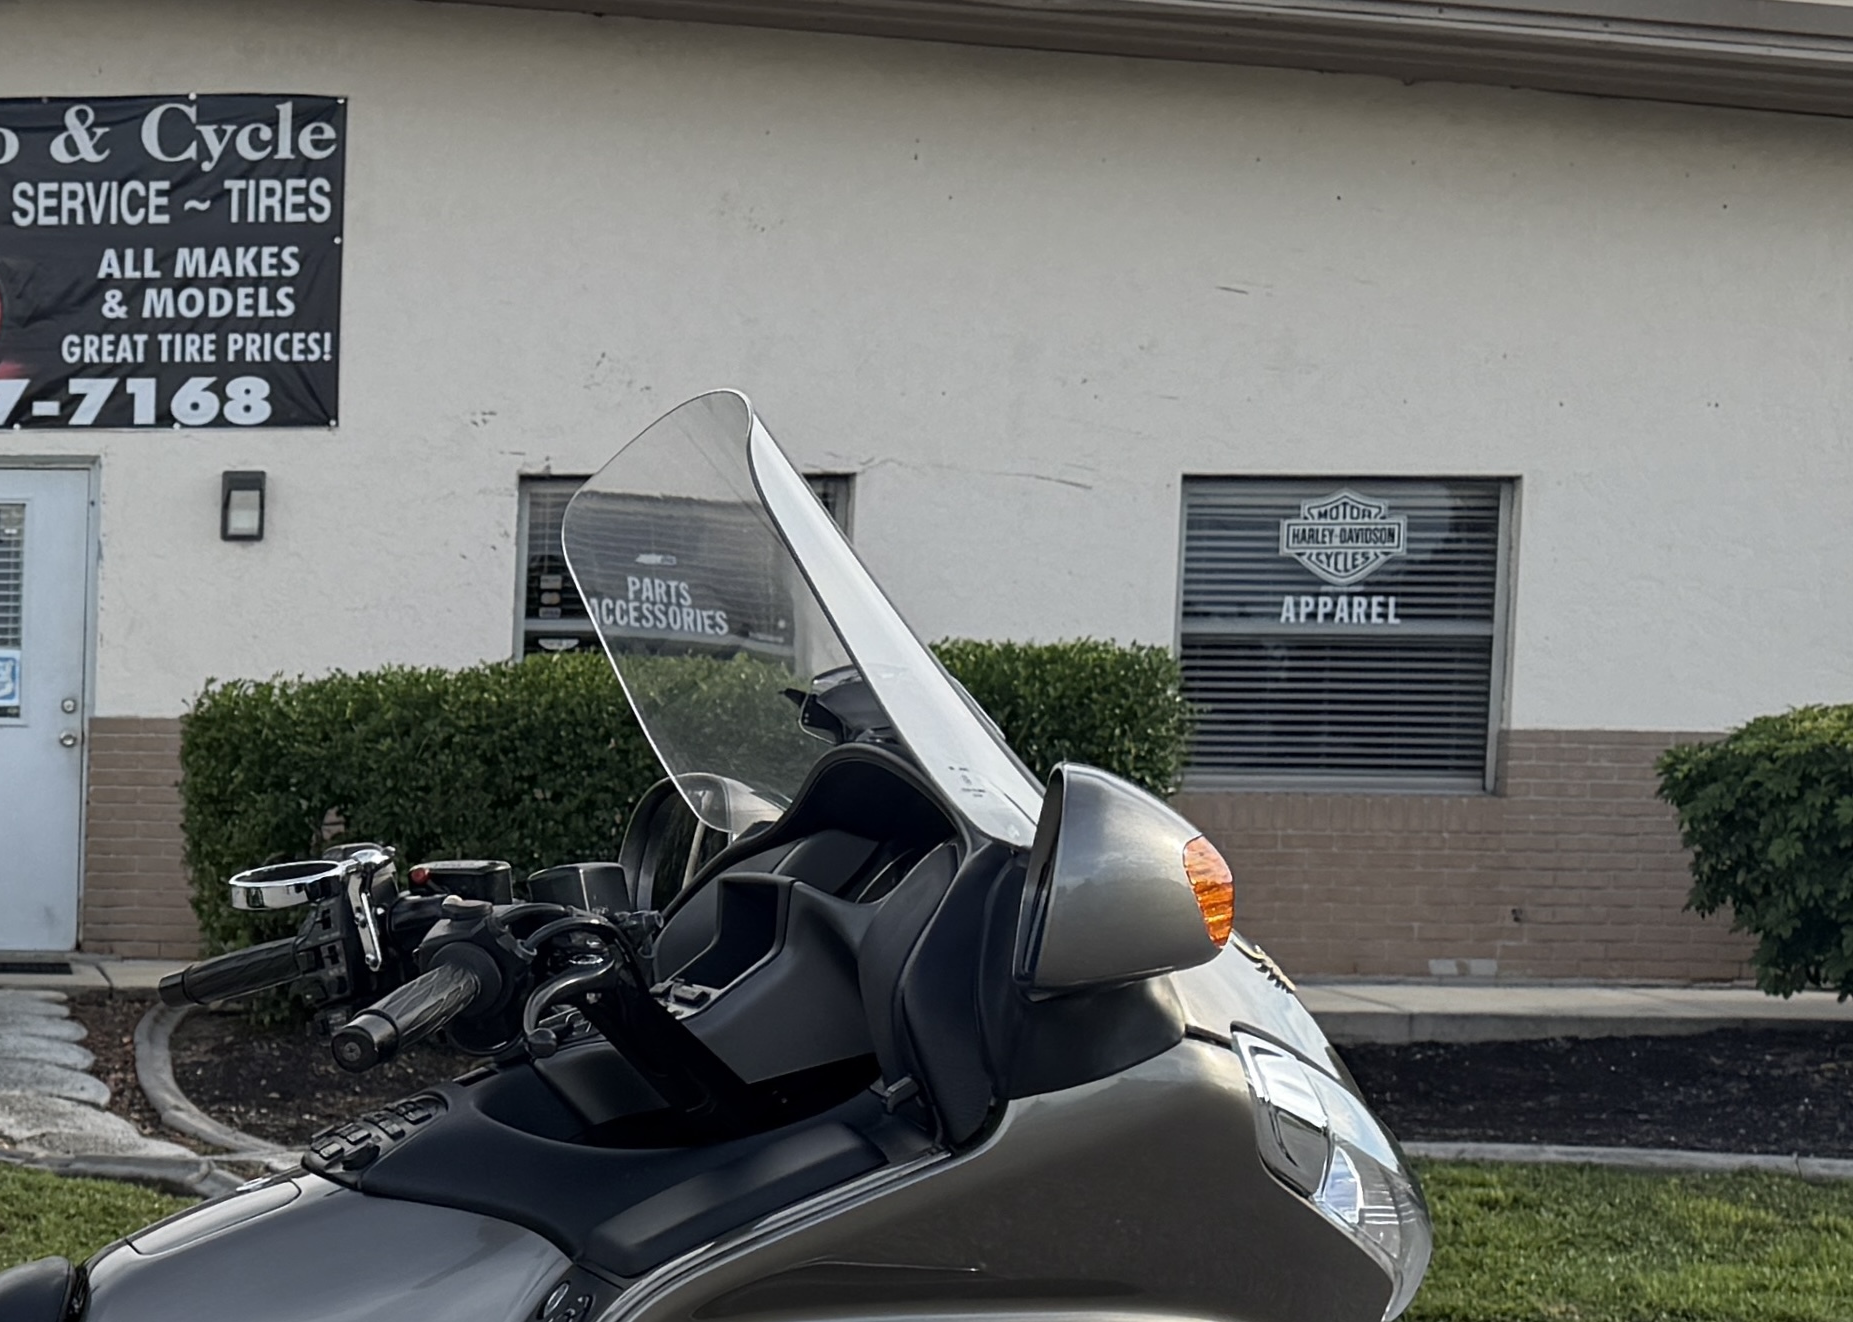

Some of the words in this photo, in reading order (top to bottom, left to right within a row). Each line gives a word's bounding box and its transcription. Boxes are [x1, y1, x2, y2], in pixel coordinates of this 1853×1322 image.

[50, 105, 110, 164] &
[142, 102, 336, 171] Cycle
[12, 181, 170, 226] SERVICE
[224, 178, 331, 223] TIRES
[98, 248, 161, 278] ALL
[175, 246, 299, 278] MAKES
[102, 290, 128, 318] &
[142, 287, 295, 318] MODELS
[62, 334, 147, 363] GREAT
[158, 334, 216, 362] TIRE
[228, 332, 332, 361] PRICES!
[1317, 501, 1372, 520] MOTOR
[1292, 527, 1396, 545] HARLEY-DAVIDSON
[1315, 551, 1371, 573] CYCLES
[627, 576, 692, 606] PARTS
[1280, 595, 1401, 624] APPAREL
